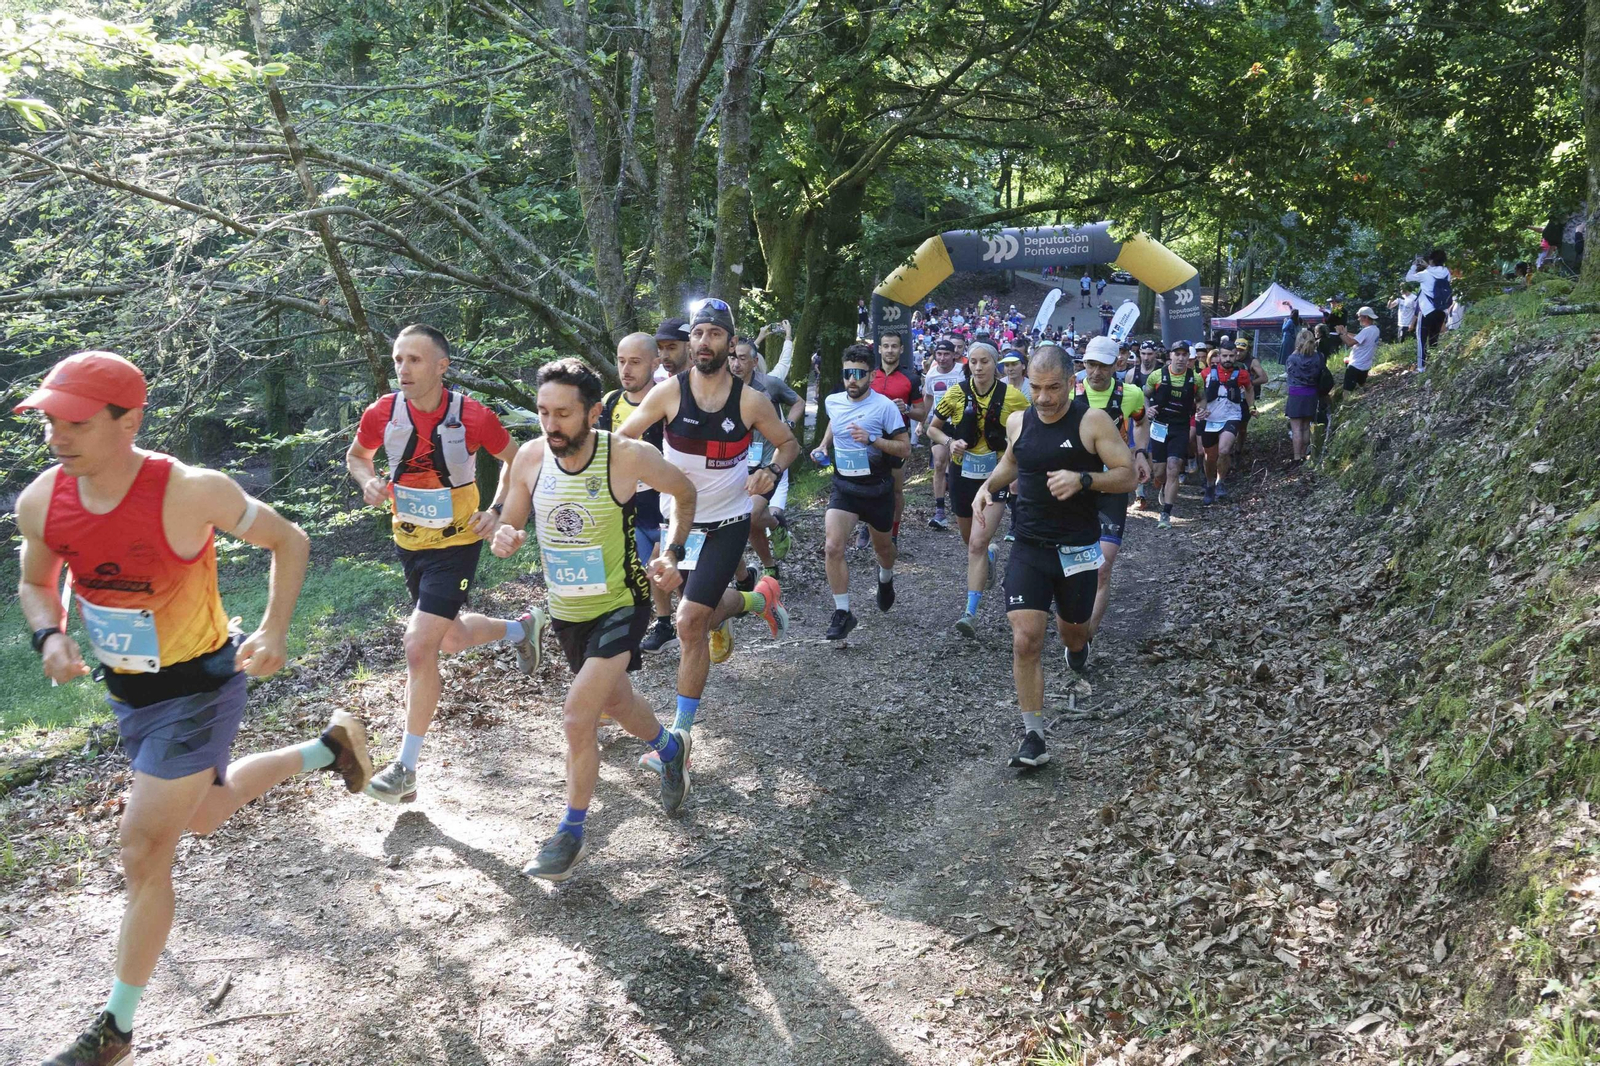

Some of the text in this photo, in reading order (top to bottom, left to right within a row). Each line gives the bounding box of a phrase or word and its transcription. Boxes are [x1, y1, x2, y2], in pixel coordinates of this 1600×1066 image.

[1024, 232, 1089, 247] Deputación
[1024, 244, 1089, 256] Pontevedra
[845, 459, 855, 469] 71
[973, 463, 987, 472] 112
[408, 502, 437, 517] 349
[1074, 548, 1098, 562] 493
[555, 567, 589, 582] 454
[93, 627, 133, 652] 347
